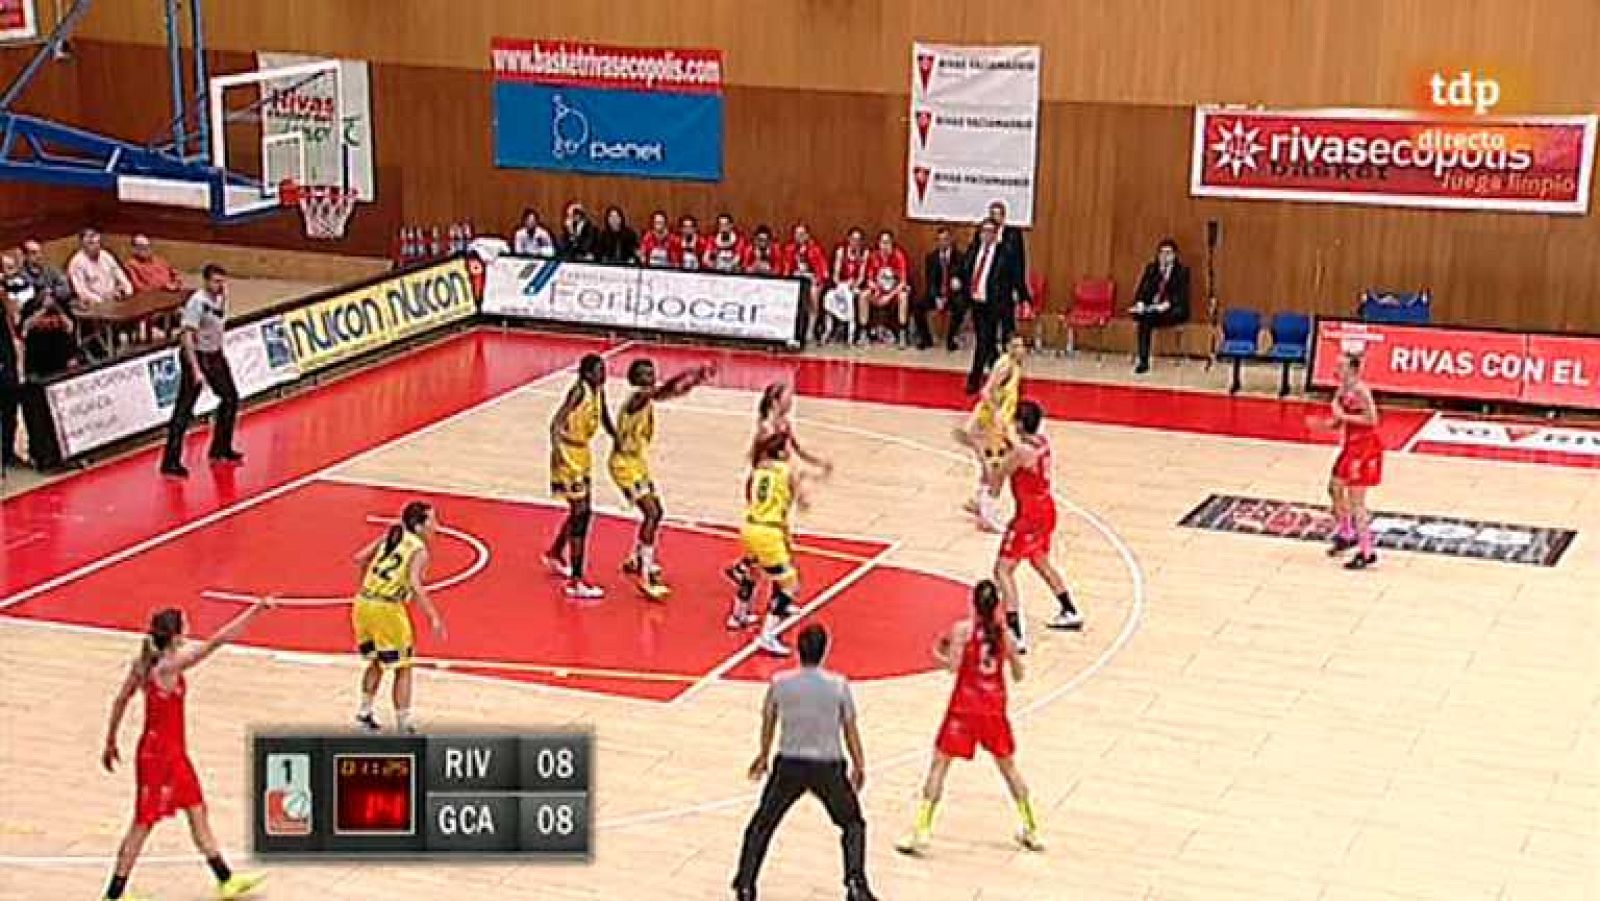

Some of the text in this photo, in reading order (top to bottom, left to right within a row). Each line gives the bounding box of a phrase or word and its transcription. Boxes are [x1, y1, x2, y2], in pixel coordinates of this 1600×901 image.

[1390, 345, 1590, 385] RIVAS CON EL
